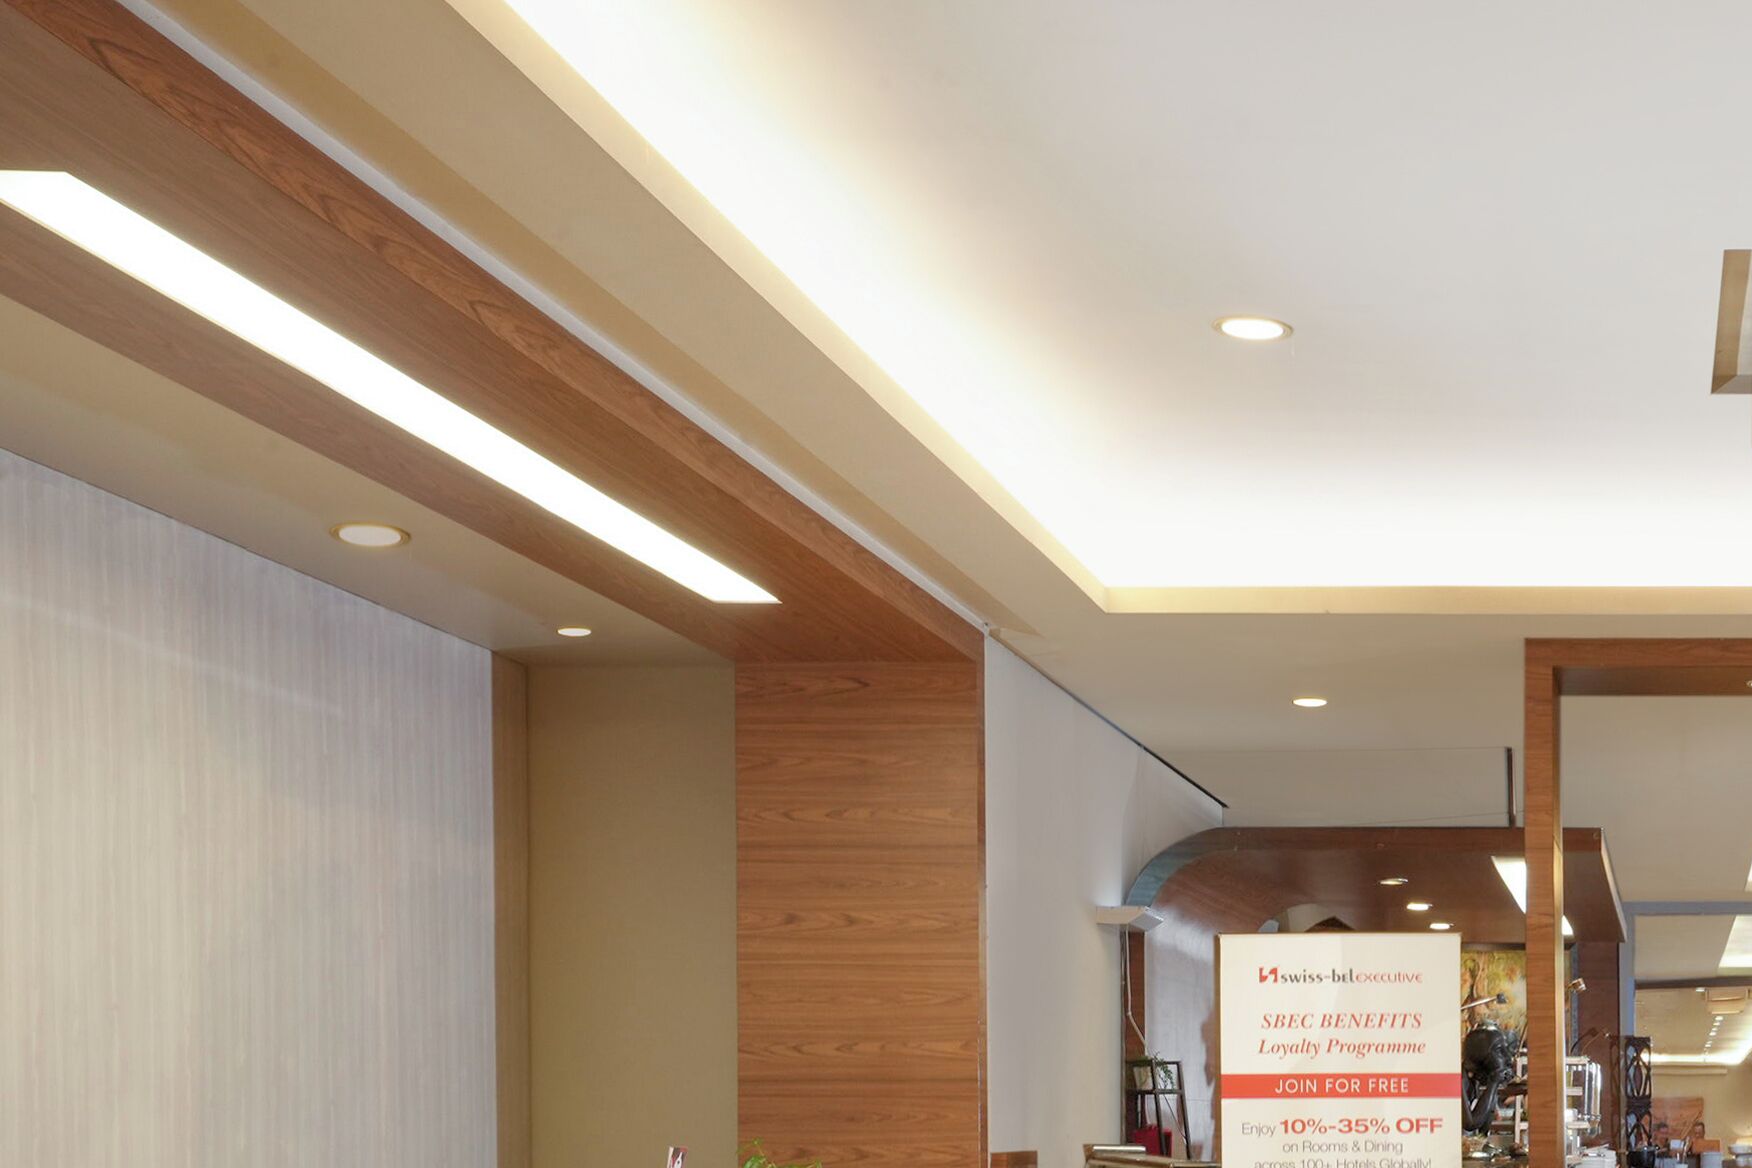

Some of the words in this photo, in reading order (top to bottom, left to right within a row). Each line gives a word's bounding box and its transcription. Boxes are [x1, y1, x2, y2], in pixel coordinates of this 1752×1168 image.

[1261, 1013, 1314, 1029] SBEC
[1319, 1012, 1422, 1029] BENEFITS
[1258, 1038, 1320, 1059] Loyalty
[1326, 1038, 1426, 1058] Programme
[1275, 1079, 1317, 1093] JOIN
[1325, 1078, 1361, 1093] FOR
[1368, 1078, 1409, 1093] FREE
[1241, 1122, 1276, 1137] Enjoy
[1280, 1118, 1390, 1134] 10%-35%
[1396, 1117, 1443, 1134] OFF
[1282, 1143, 1298, 1152] on
[1302, 1141, 1348, 1152] Rooms
[1351, 1141, 1361, 1152] &
[1364, 1140, 1403, 1154] Dining
